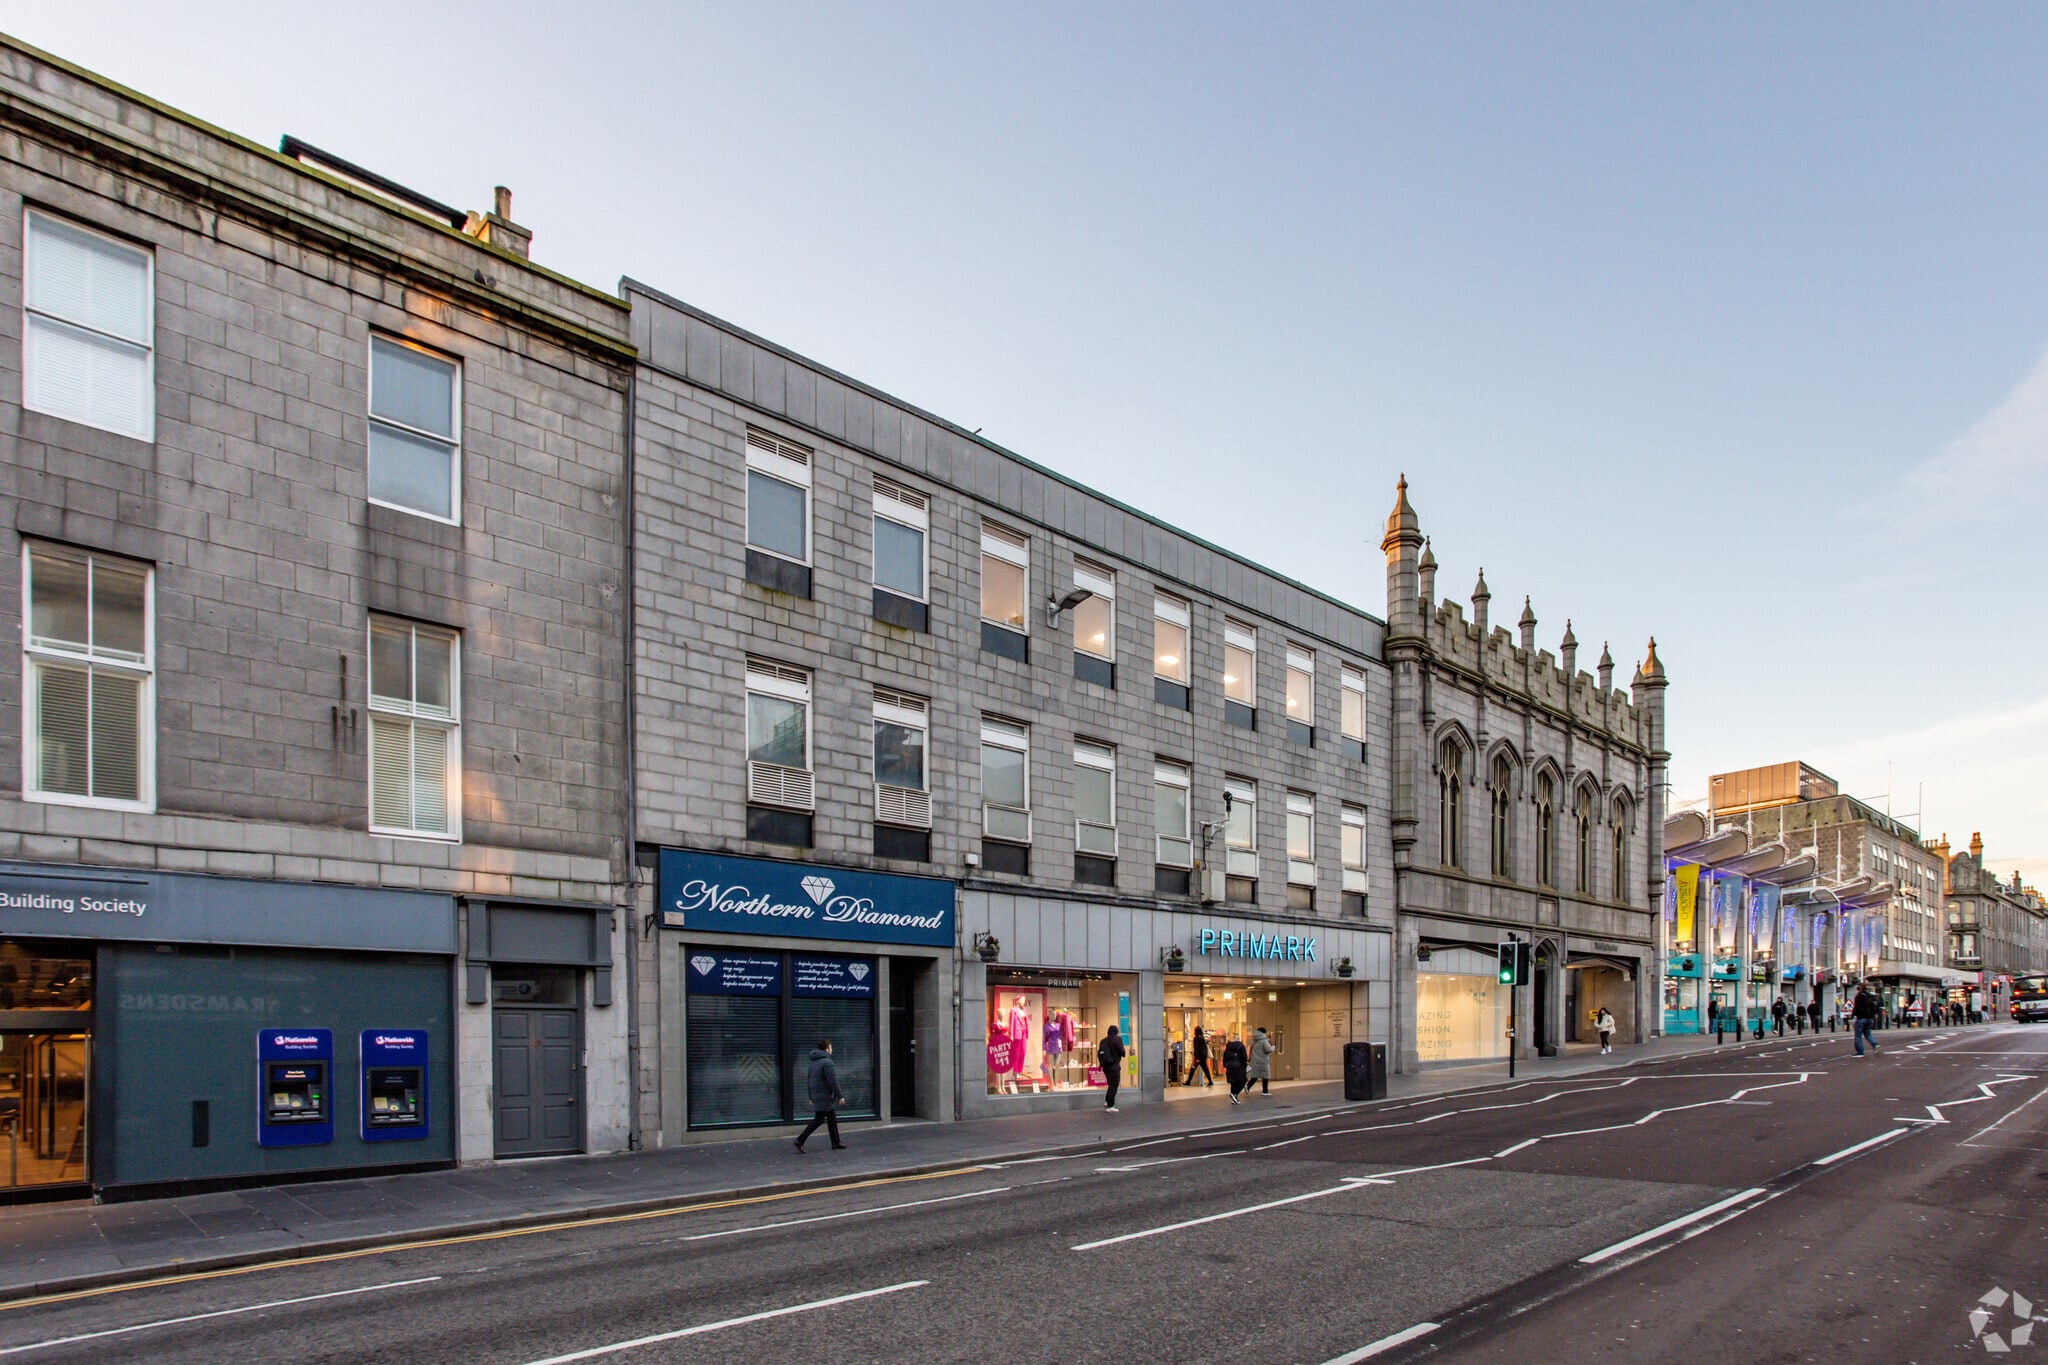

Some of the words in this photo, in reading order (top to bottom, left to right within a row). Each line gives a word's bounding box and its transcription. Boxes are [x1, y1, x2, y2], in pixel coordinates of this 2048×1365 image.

[0, 892, 75, 913] Building
[80, 897, 147, 916] Society
[676, 880, 814, 919] Northern
[822, 896, 944, 928] Diamond
[1200, 928, 1316, 962] PRIMARK
[1048, 979, 1083, 987] PRIMARK
[989, 1042, 1012, 1054] PARTY
[1418, 1040, 1452, 1048] AZING
[994, 1050, 1009, 1059] FROM
[995, 1056, 1010, 1066] £11
